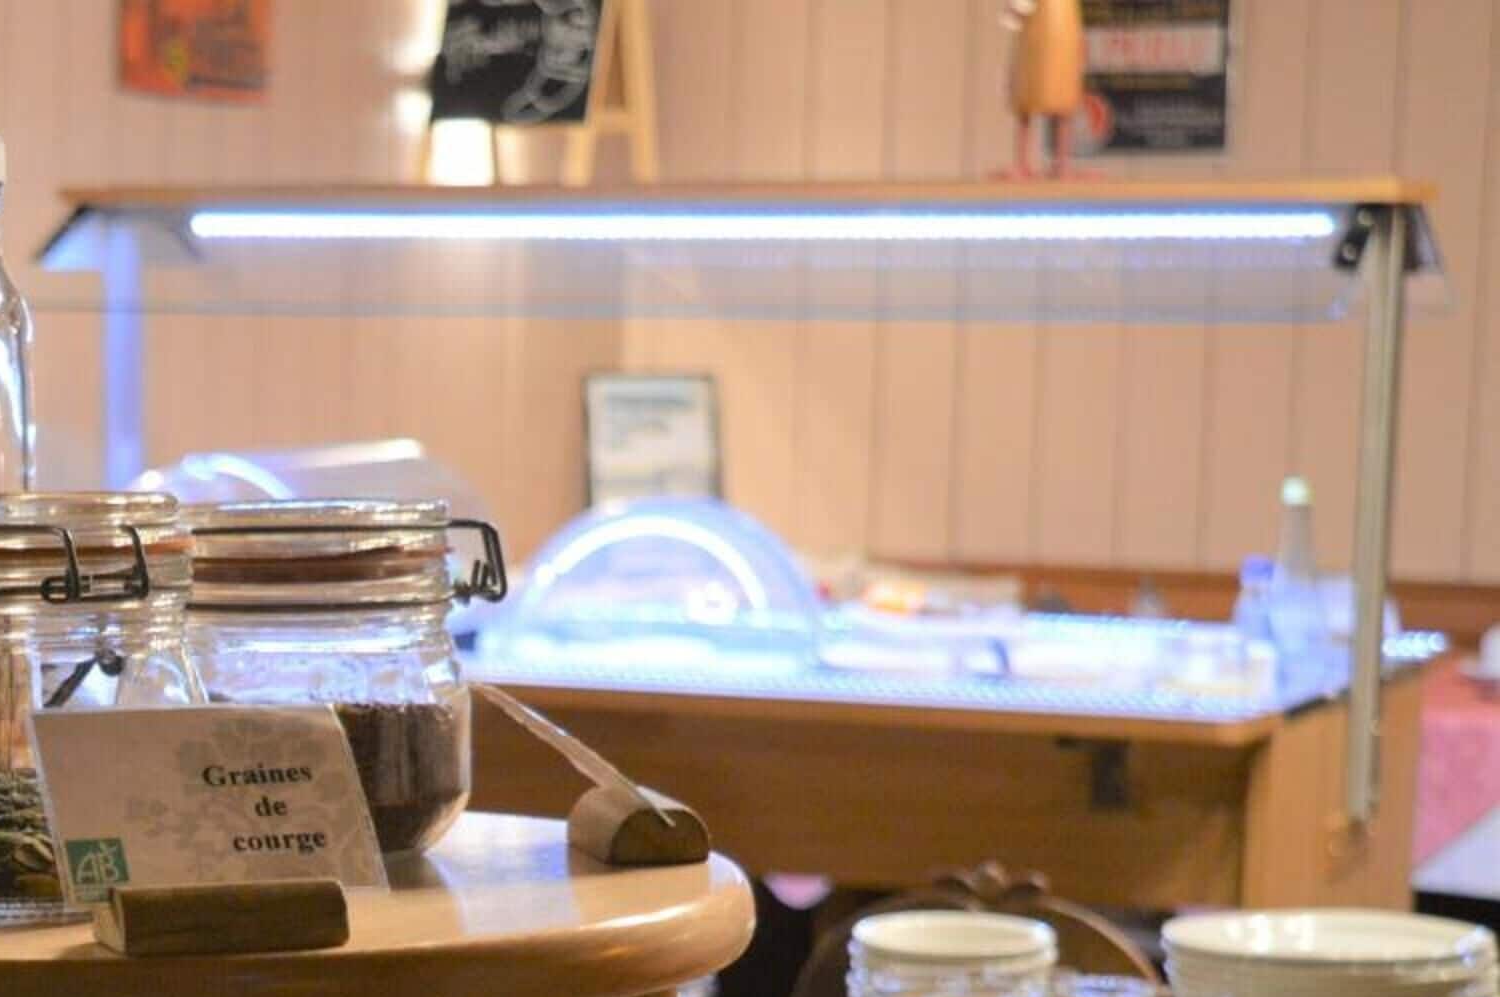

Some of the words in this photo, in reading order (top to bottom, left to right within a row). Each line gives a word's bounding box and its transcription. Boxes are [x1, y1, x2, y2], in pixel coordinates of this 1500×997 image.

[202, 763, 313, 786] Graines
[255, 796, 288, 816] de
[233, 832, 325, 853] courge
[76, 852, 118, 883] AB
